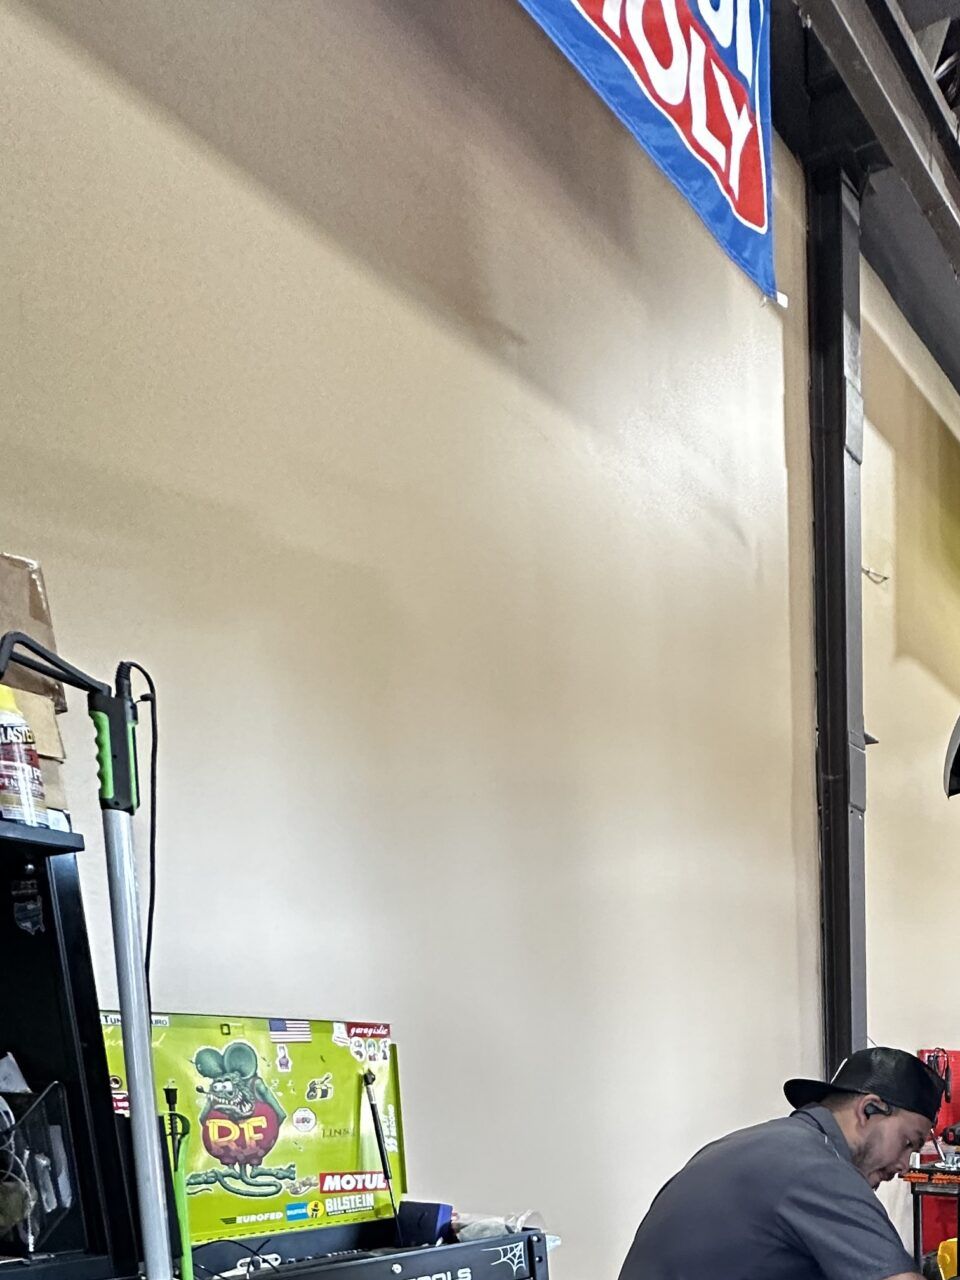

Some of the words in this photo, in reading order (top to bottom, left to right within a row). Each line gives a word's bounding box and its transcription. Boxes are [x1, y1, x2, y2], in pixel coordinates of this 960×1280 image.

[0, 726, 35, 743] LASTE
[350, 1025, 388, 1037] garagistic
[323, 1173, 387, 1191] MOTUL
[325, 1193, 374, 1213] BILSTEIN
